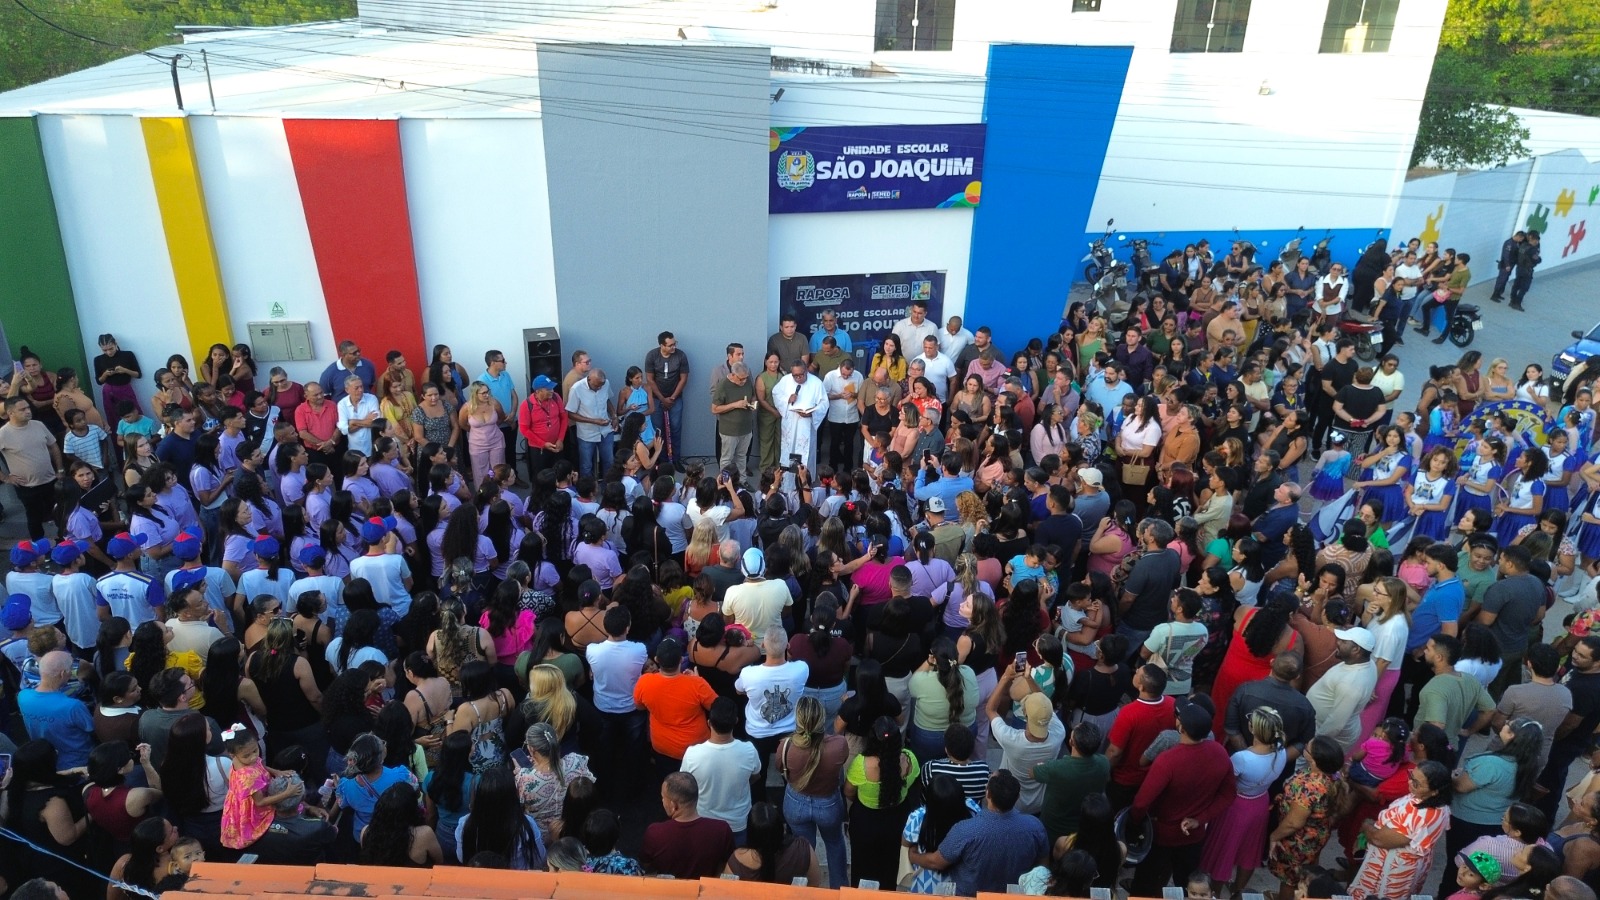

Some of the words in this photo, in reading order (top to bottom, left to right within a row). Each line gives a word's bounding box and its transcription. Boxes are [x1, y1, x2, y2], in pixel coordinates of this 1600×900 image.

[842, 145, 891, 155] UNIDADE
[897, 143, 949, 154] ESCOLAR
[816, 155, 865, 180] SÃO
[870, 157, 974, 182] JOAQUIM
[795, 287, 850, 301] RAPOSA
[872, 284, 910, 294] SEMED
[816, 310, 859, 320] UDADE
[863, 308, 905, 317] ESCOLAR
